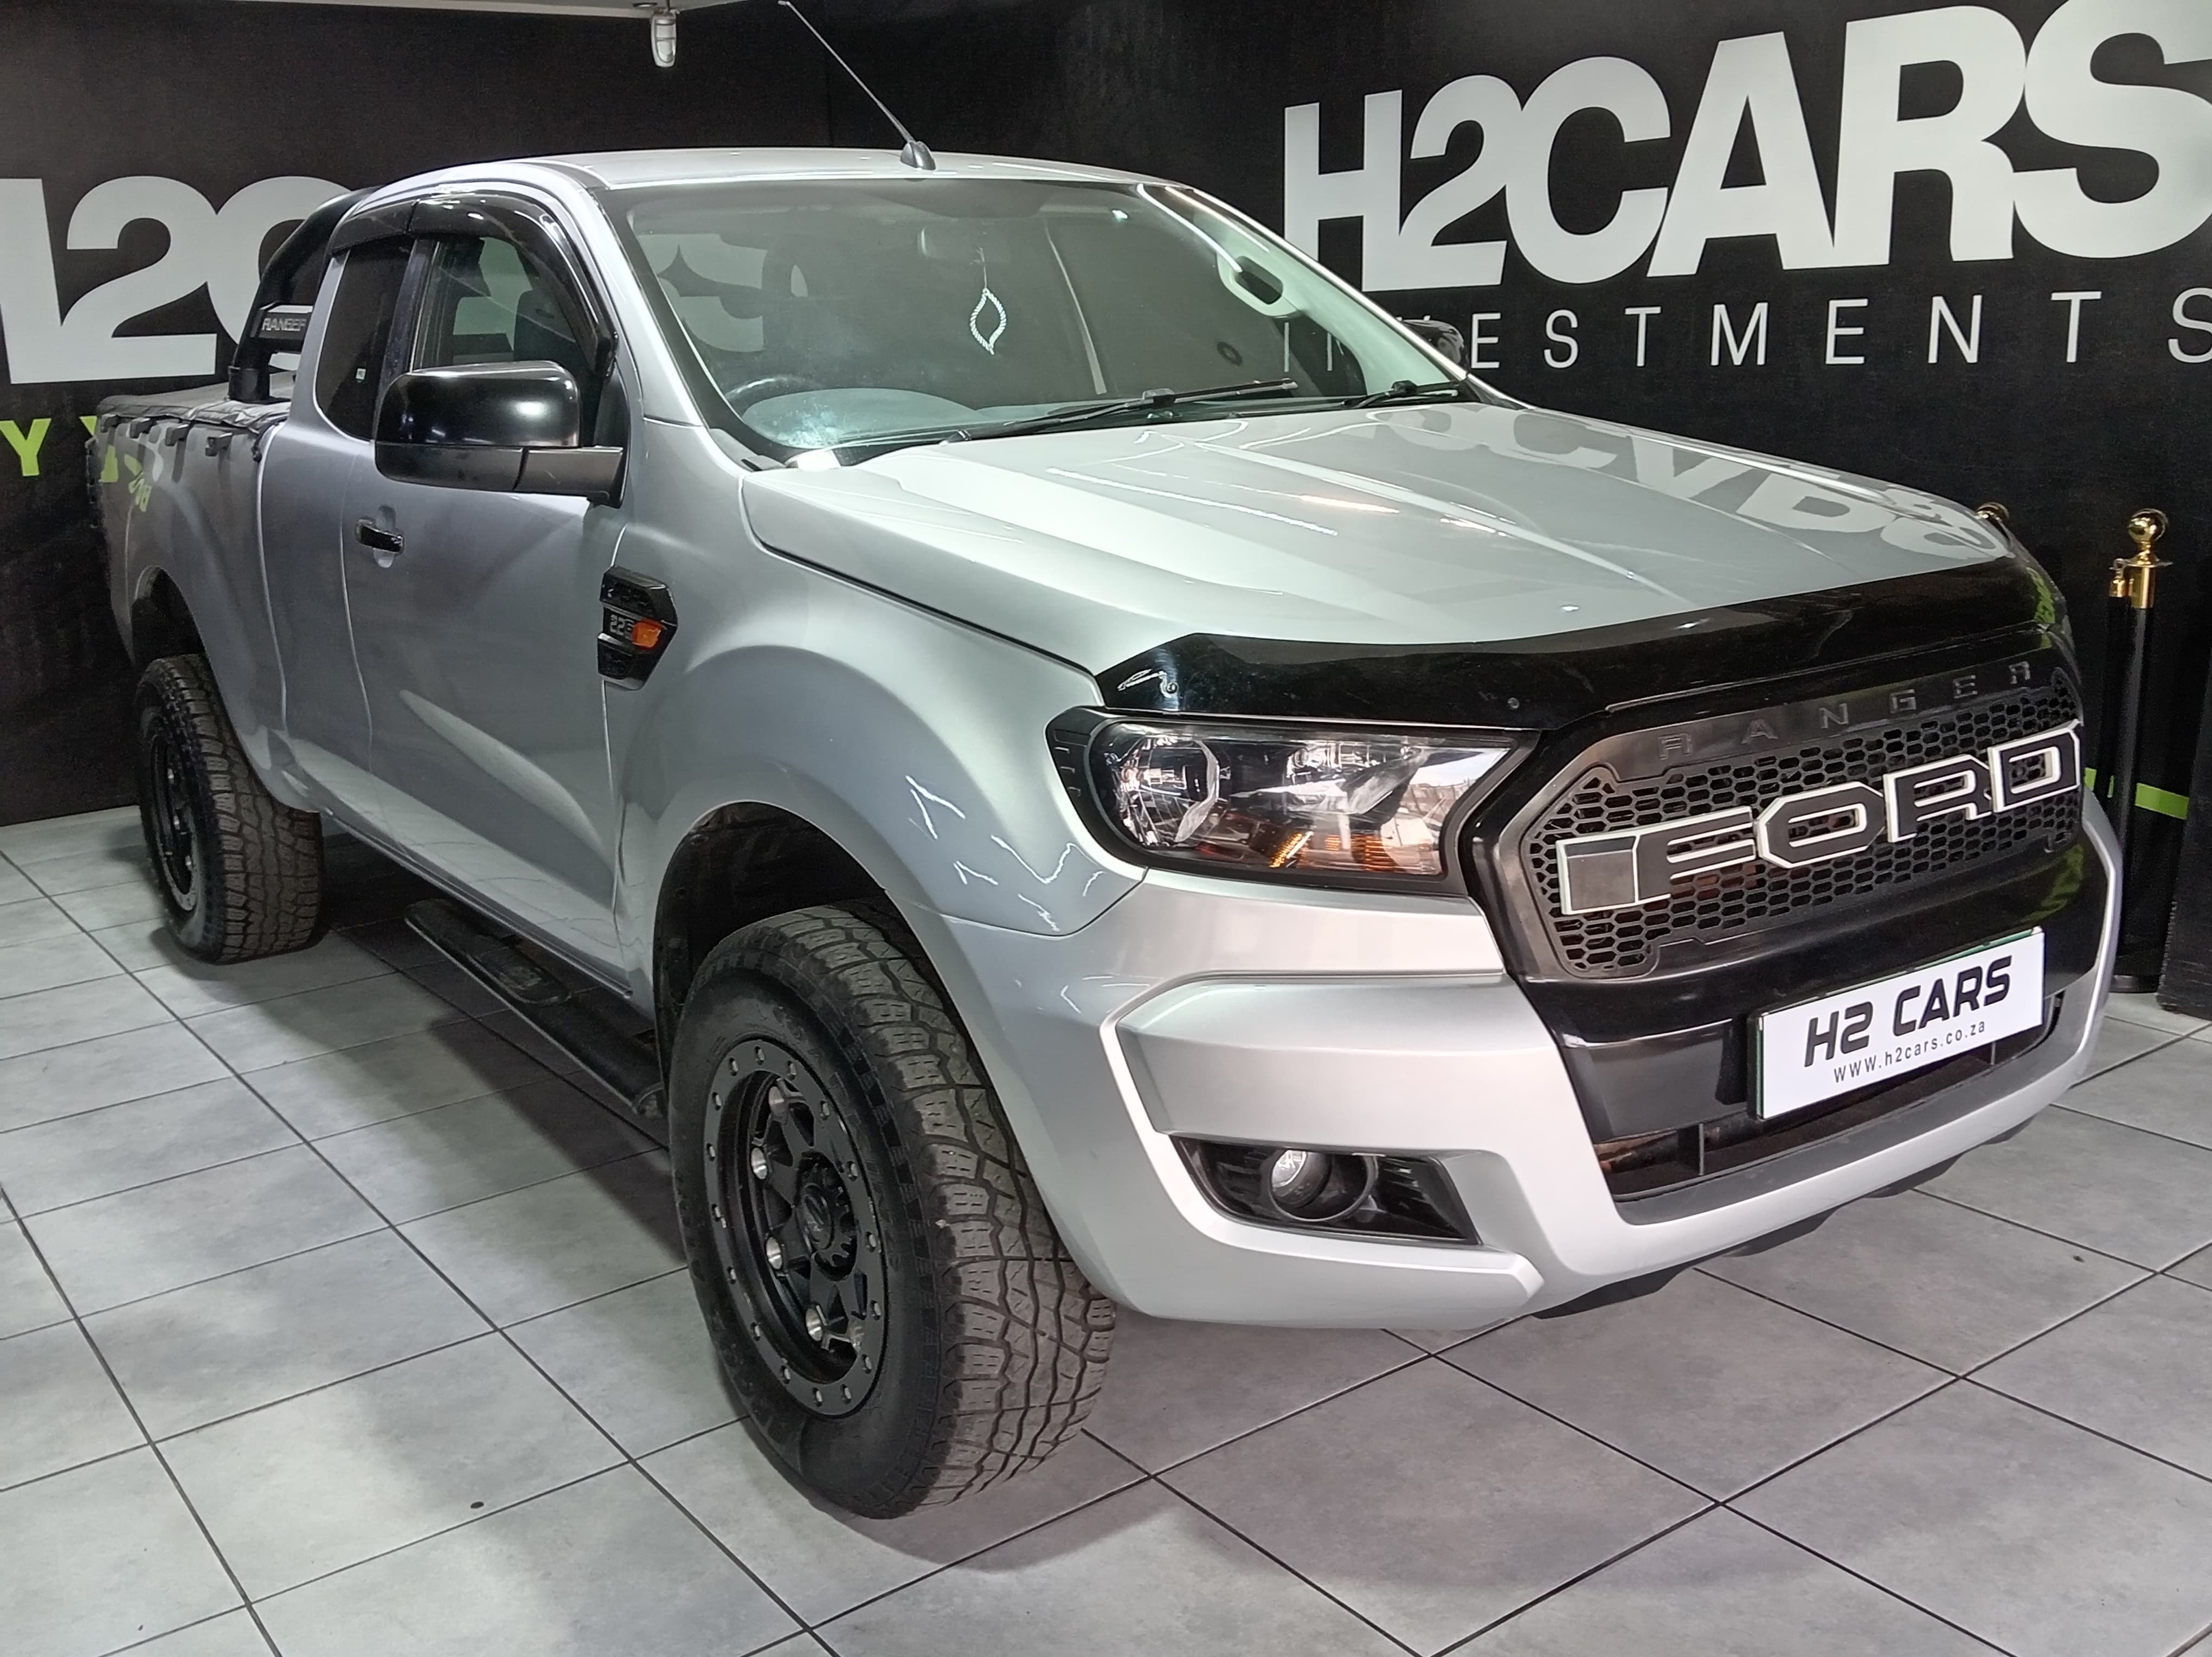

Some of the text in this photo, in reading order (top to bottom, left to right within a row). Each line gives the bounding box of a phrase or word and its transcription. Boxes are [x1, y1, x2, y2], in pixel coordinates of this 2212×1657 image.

[1284, 0, 2212, 292] H2CARS
[1657, 660, 2032, 760] RANGER
[1632, 720, 2081, 905] FORD
[1804, 954, 2012, 1068] H2 CARS
